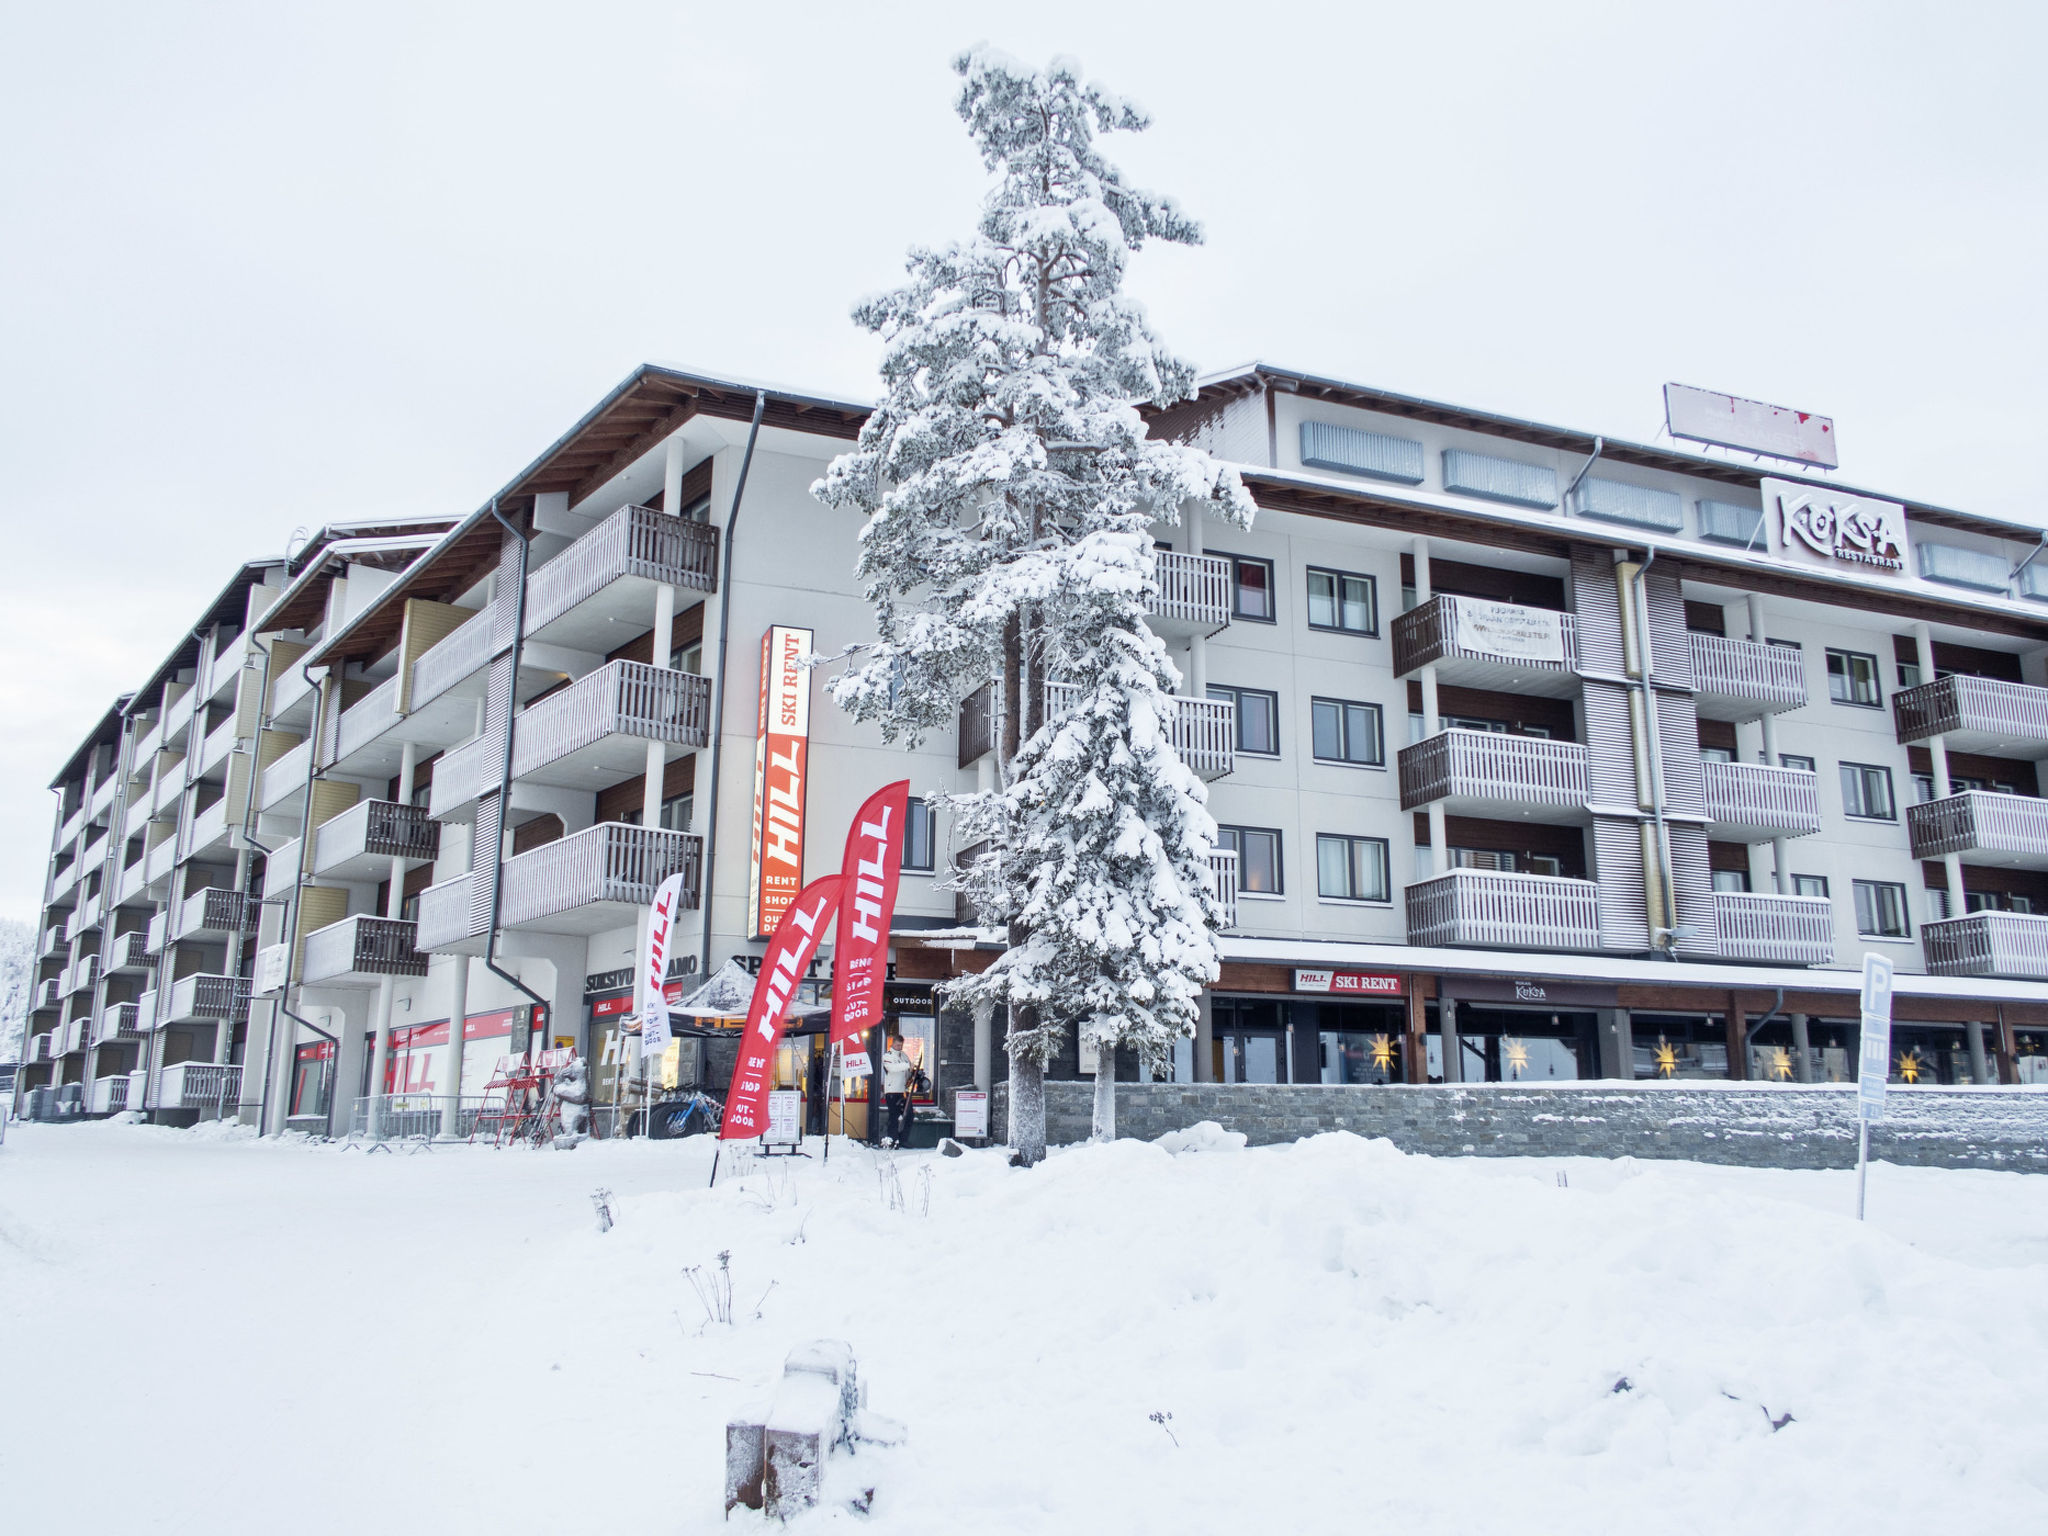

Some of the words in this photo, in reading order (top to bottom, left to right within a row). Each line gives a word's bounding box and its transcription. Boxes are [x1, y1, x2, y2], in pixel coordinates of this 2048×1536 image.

[1835, 548, 1904, 570] RESTAURANT
[783, 633, 800, 689] RENT
[781, 692, 797, 726] SKI
[766, 740, 801, 868] HILL
[766, 875, 797, 887] RENT
[851, 804, 893, 945] HILL
[650, 891, 672, 993] HILL
[758, 895, 828, 1043] HILL
[1299, 973, 1327, 983] HILL
[1335, 975, 1359, 989] SKI
[1361, 977, 1398, 990] RENT
[892, 996, 933, 1005] OUTDOOR
[1868, 963, 1889, 1010] P
[846, 1058, 867, 1069] HILL
